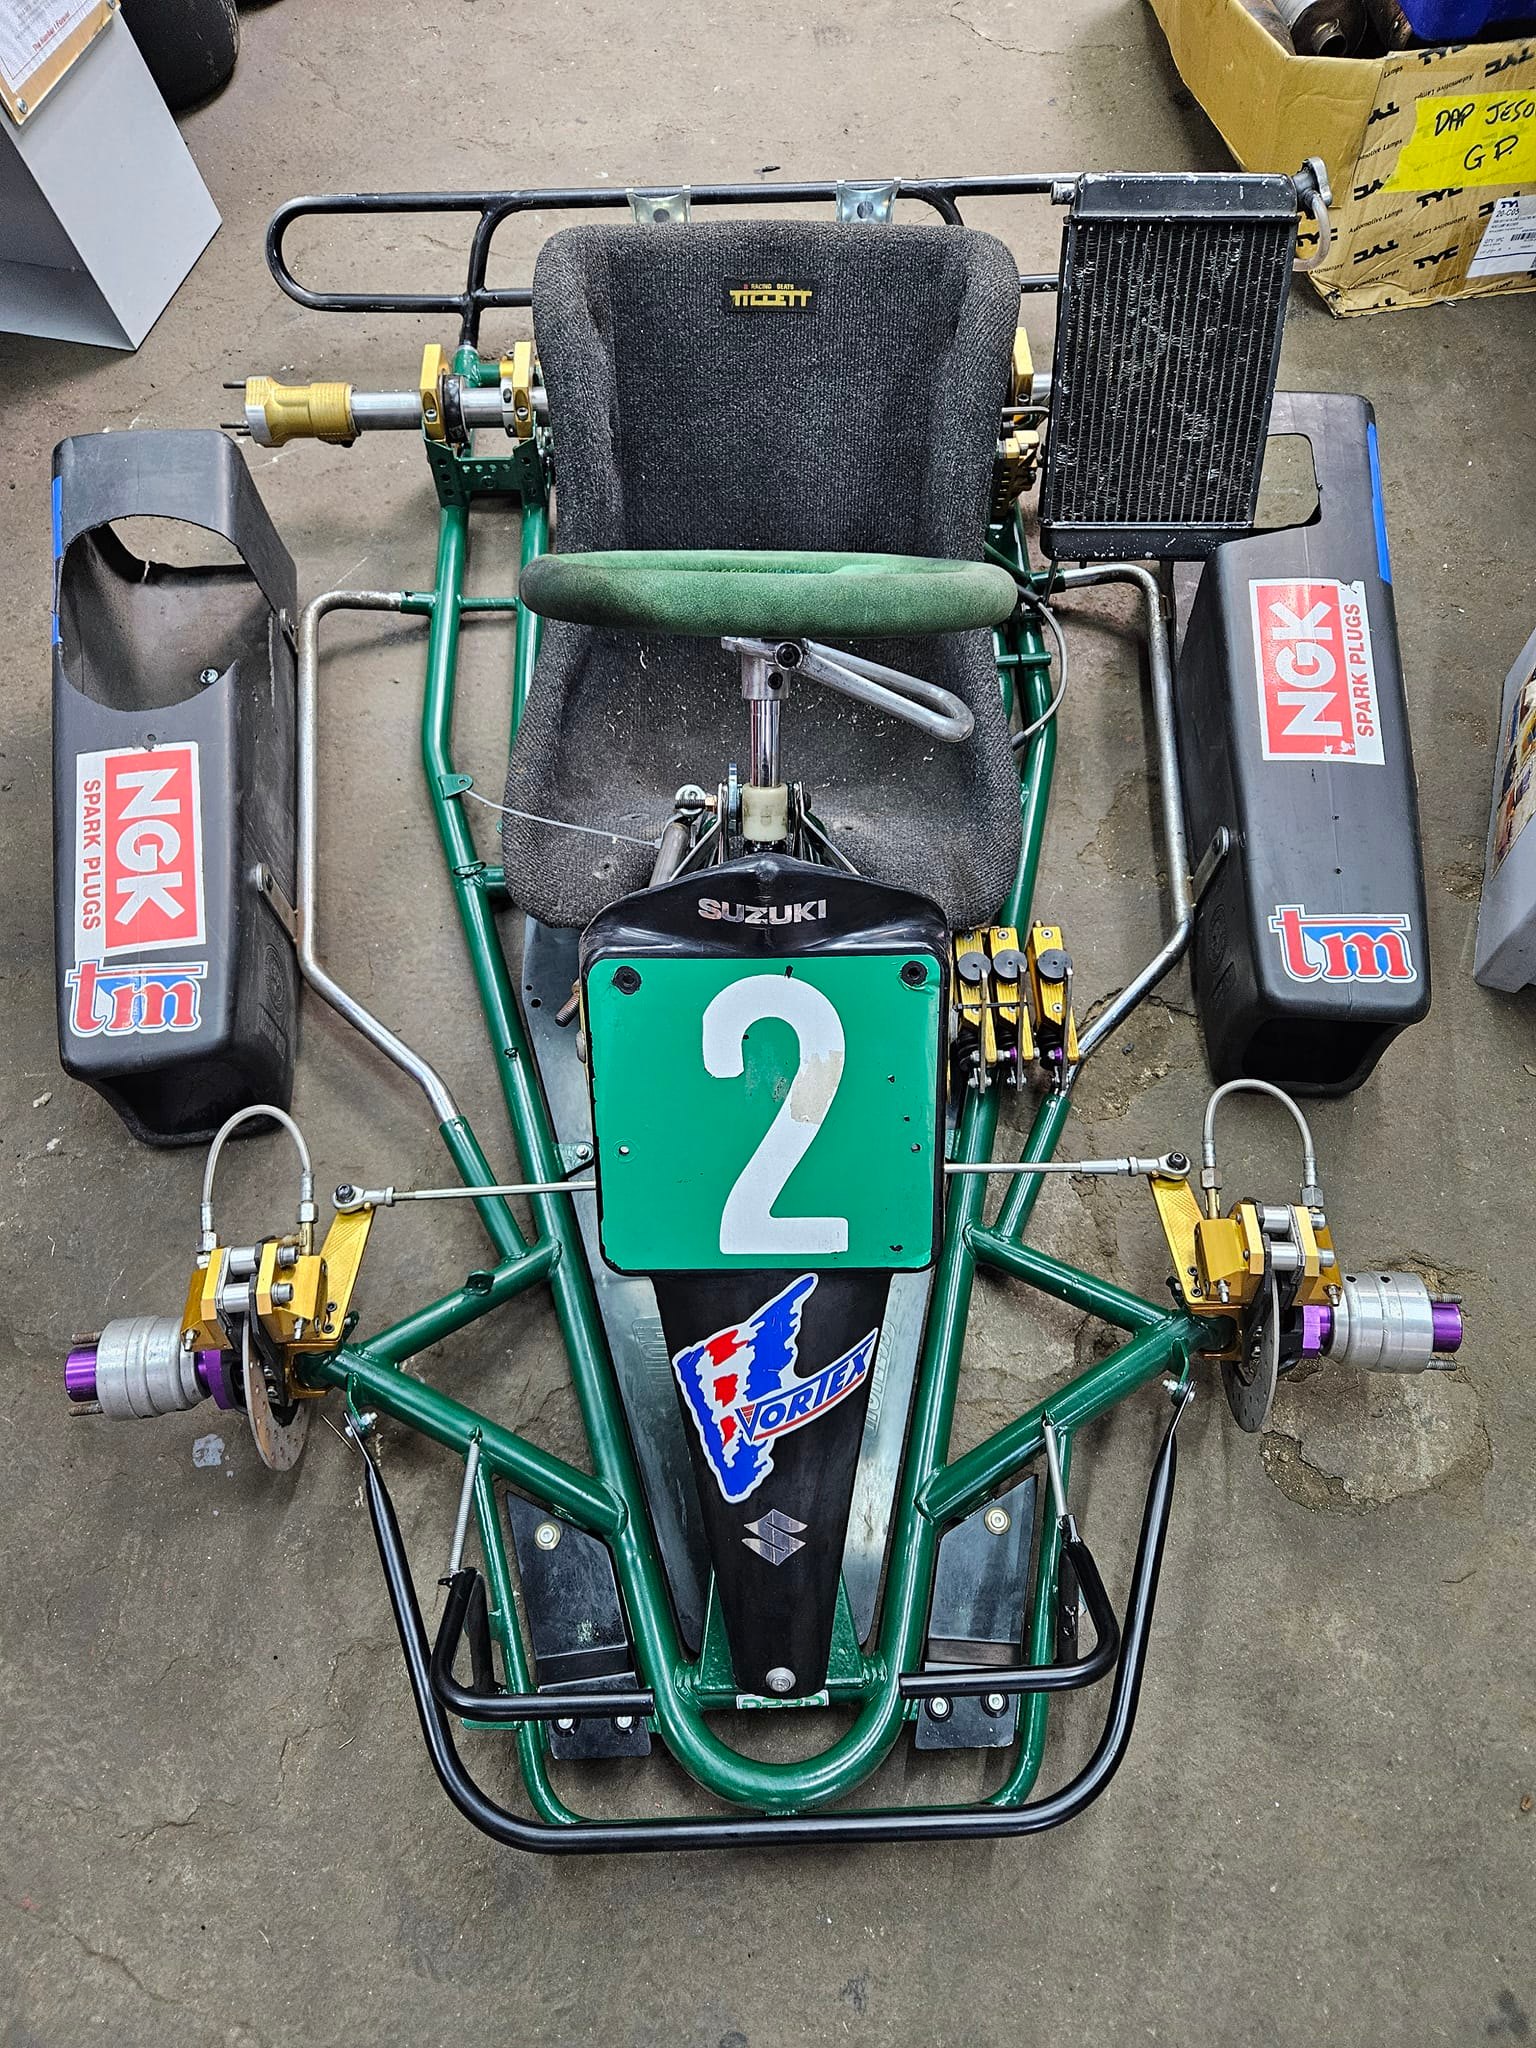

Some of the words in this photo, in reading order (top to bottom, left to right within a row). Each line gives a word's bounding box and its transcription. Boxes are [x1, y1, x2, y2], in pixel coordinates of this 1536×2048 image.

[1383, 66, 1403, 79] Lamps
[1485, 47, 1535, 78] TYC
[1368, 101, 1400, 126] TY
[1435, 103, 1475, 136] DAP
[1348, 216, 1383, 235] Automotive
[1383, 208, 1404, 221] Lamps
[1432, 214, 1469, 232] Automotive
[1353, 239, 1400, 265] TYC
[1413, 244, 1459, 269] TYC
[1380, 268, 1400, 281] Lamps
[1343, 603, 1367, 665] PLUGS
[1268, 601, 1344, 737] NGK
[1350, 671, 1375, 737] SPARK
[82, 779, 101, 850] SPARK
[114, 767, 186, 926] NGK
[82, 856, 101, 931] PLUGS
[698, 898, 826, 925] SUZUKI
[702, 974, 849, 1255] 2
[734, 1347, 869, 1442] VORTEX
